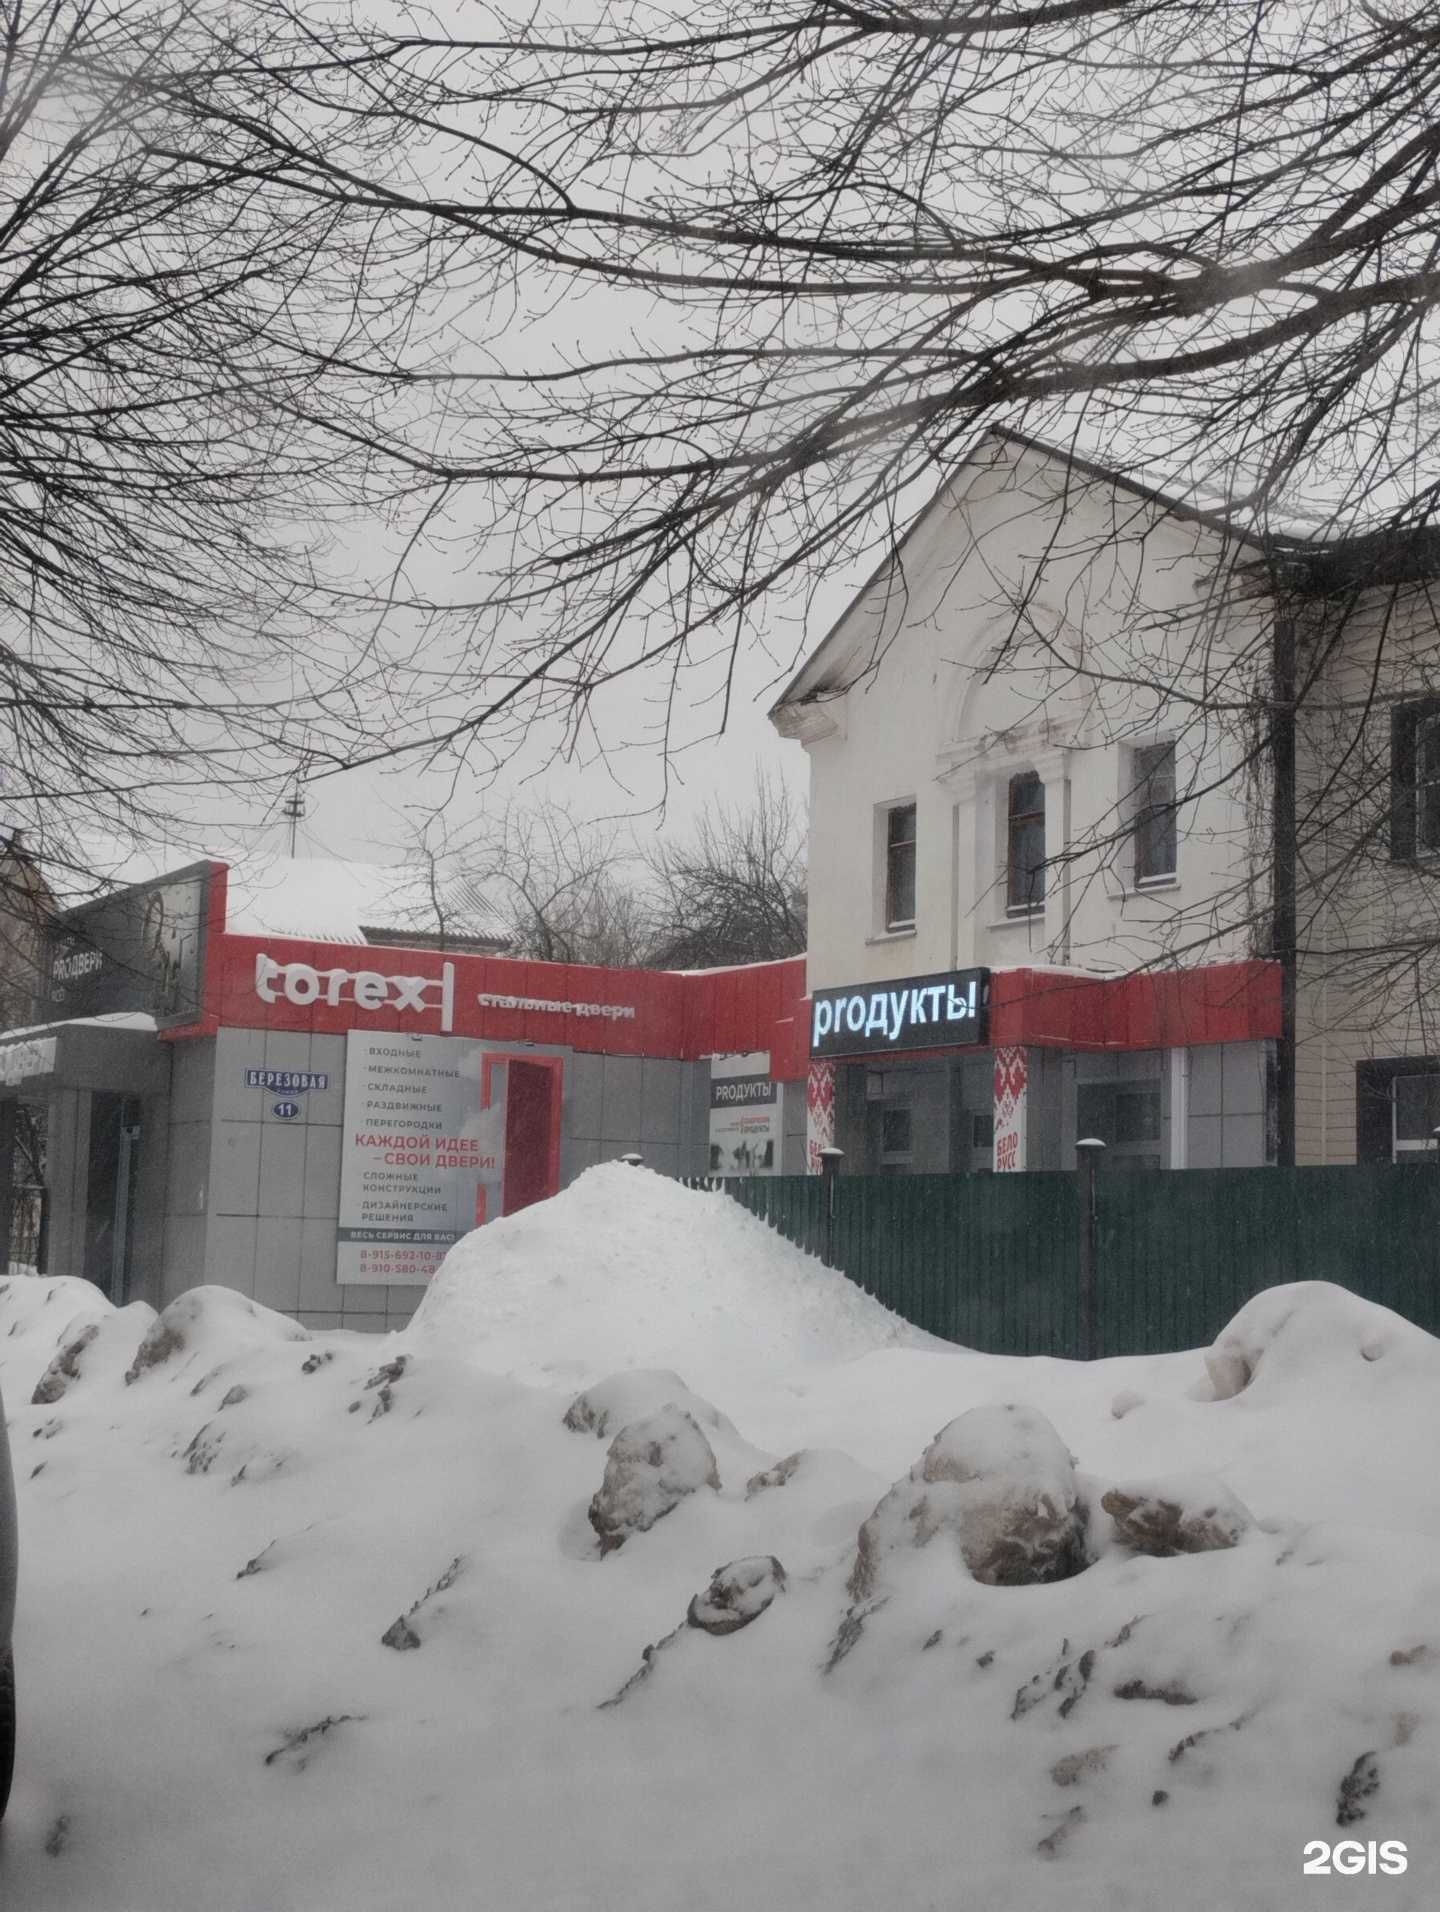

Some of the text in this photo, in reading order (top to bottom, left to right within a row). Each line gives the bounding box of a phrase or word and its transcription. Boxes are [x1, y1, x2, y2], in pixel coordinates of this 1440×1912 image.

[575, 1002, 635, 1020] двери
[368, 1047, 422, 1058] ВХОДНЫЕ
[368, 1065, 461, 1078] МЕЖКОМНАТНЫЕ
[249, 1071, 326, 1089] БЕРЕЗОВАЯ
[367, 1082, 428, 1094] СКЛАДНЫЕ
[278, 1104, 292, 1116] 11
[366, 1101, 443, 1112] РАЗДВИЖНЫЕ
[366, 1118, 443, 1130] ПЕРЕГОРОДКИ
[355, 1133, 479, 1153] КАЖДОЙ ИДЕЕ
[997, 1131, 1018, 1156] БЕЛО
[384, 1152, 430, 1166] СВОИ
[435, 1155, 496, 1169] ДВЕРИ!
[363, 1171, 419, 1181] СЛОЖНЫЕ
[362, 1184, 442, 1195] КОНСТРУКЦИИ
[361, 1199, 449, 1212] ДИЗАЙНЕРСКИЕ
[361, 1213, 415, 1222] РЕШЕНИЯ
[350, 1231, 375, 1240] ВЕСЬ
[376, 1231, 412, 1240] СЕРВИС
[413, 1232, 432, 1241] ДЛЯ
